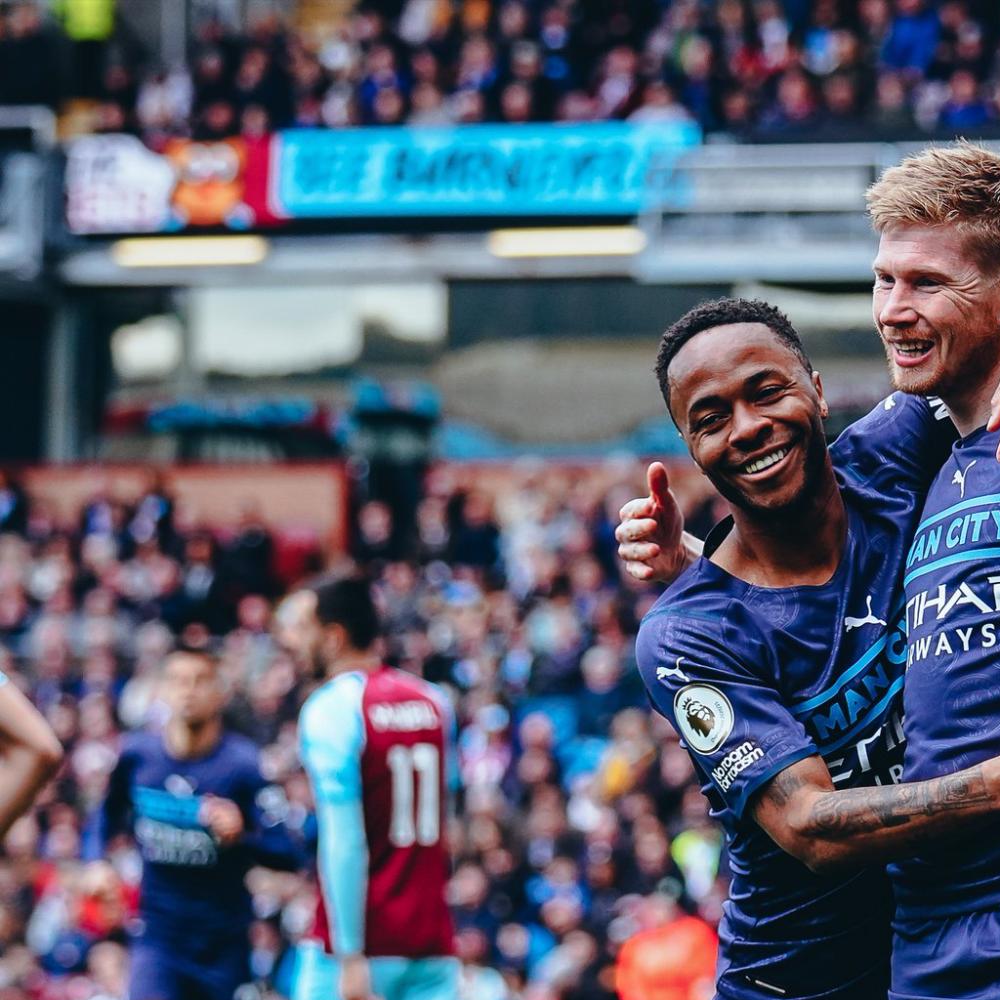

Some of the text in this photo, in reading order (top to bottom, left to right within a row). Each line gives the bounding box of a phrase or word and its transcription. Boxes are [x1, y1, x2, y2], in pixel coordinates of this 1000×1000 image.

[906, 623, 996, 669] RWAYS
[812, 662, 889, 740] MAN
[712, 741, 754, 782] No room
[718, 747, 765, 793] for racism
[386, 742, 440, 847] 11
